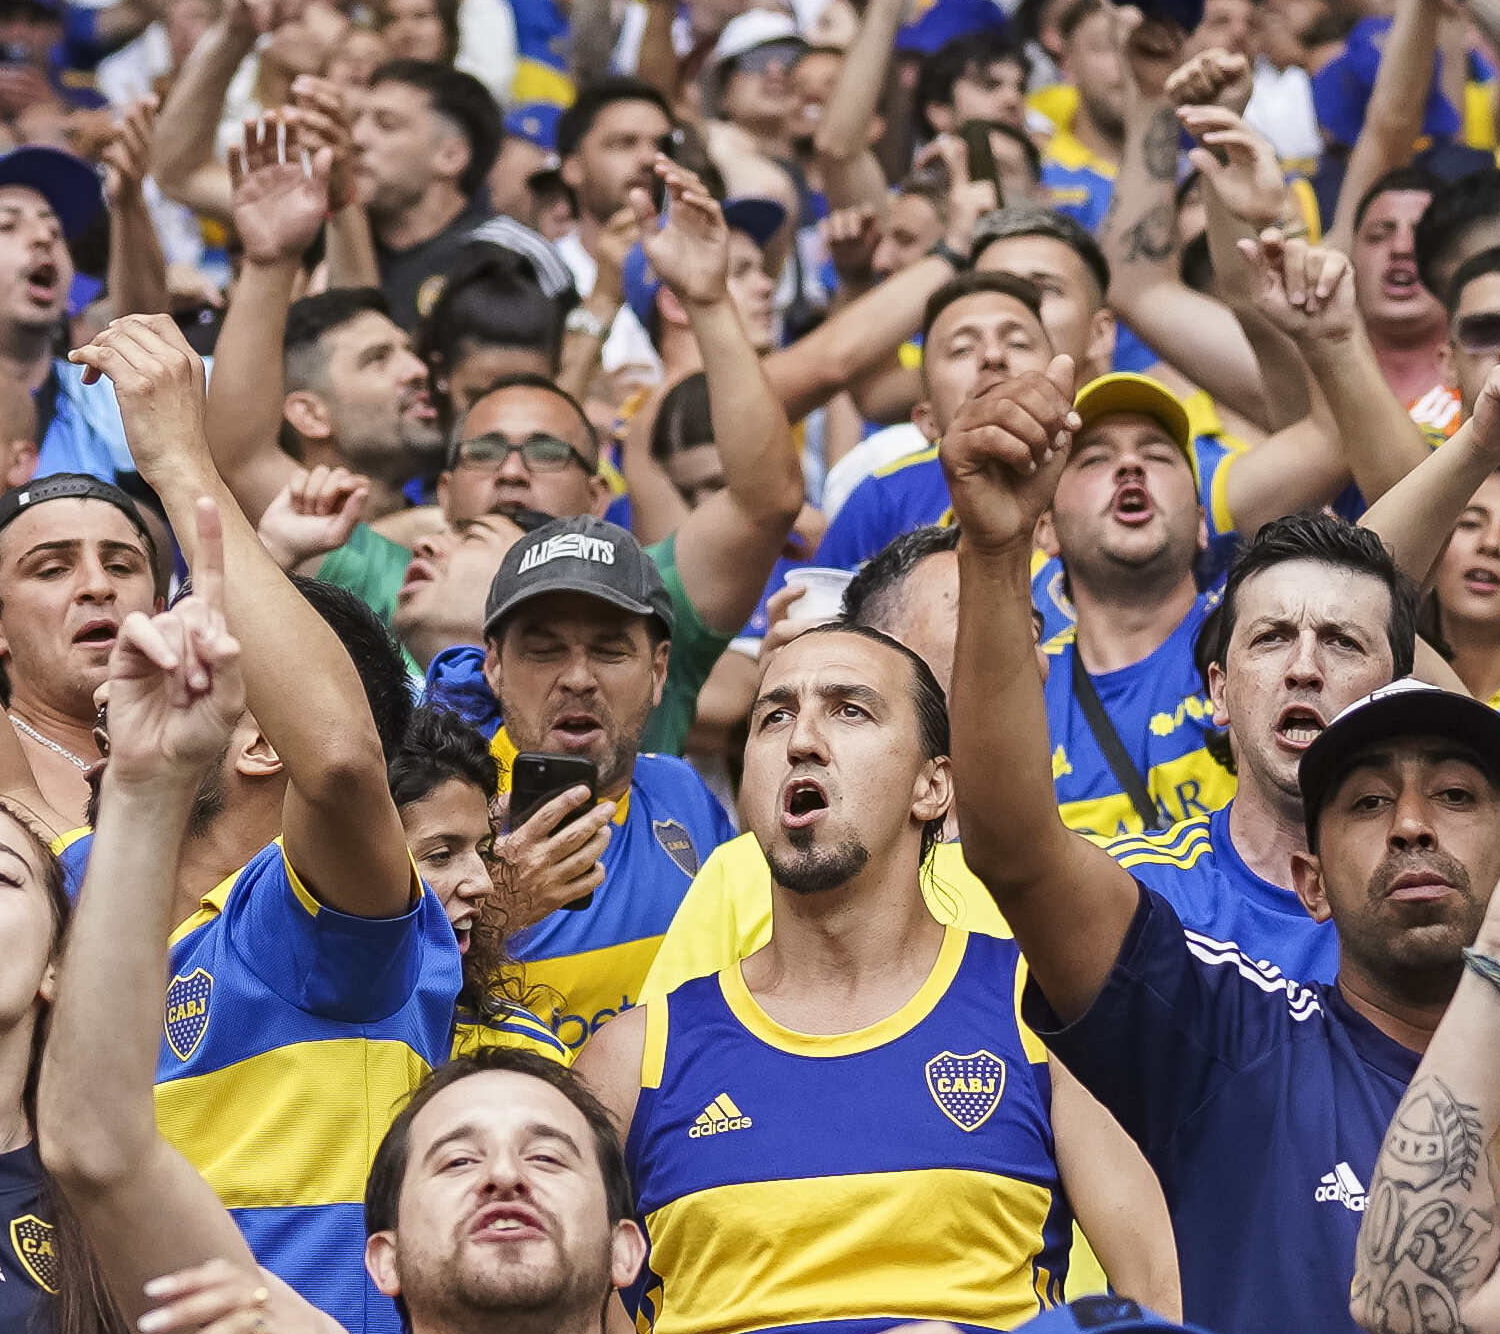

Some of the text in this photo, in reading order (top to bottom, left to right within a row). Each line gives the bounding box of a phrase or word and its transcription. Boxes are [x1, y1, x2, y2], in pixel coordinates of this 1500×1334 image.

[168, 997, 207, 1024] CABJ
[937, 1076, 997, 1094] CABJ
[688, 1114, 754, 1140] adidas
